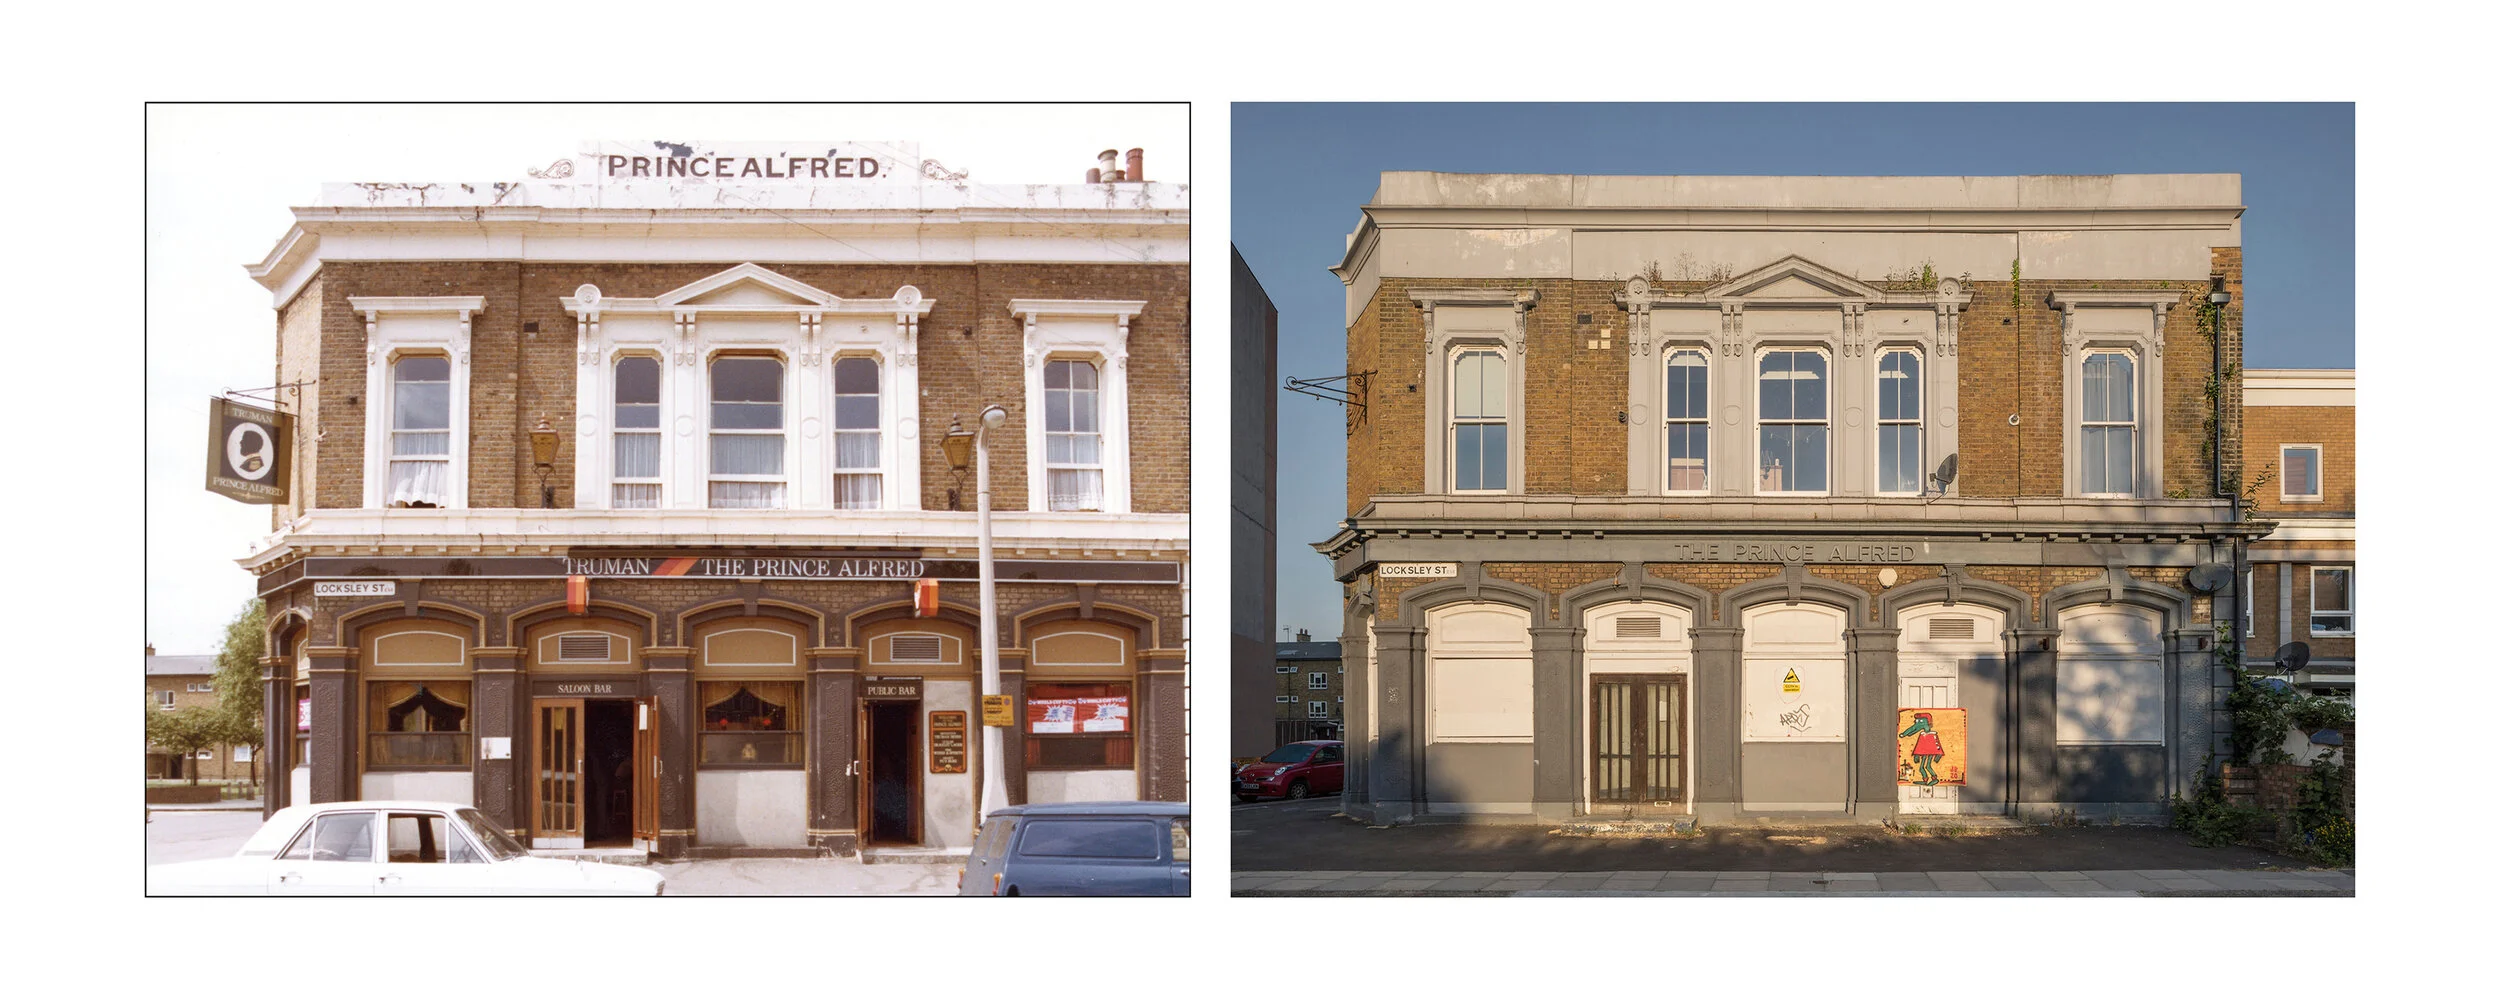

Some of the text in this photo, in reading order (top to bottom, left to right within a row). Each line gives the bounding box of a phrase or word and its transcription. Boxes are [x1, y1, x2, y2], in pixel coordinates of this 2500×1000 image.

[608, 155, 887, 179] PRINCE ALFRED.
[233, 408, 273, 424] TRUMAN
[213, 477, 284, 497] PRINCE ALFRED
[1674, 543, 1916, 562] THE PRINCE ALFRED
[563, 557, 650, 575] TRUMAN
[701, 558, 925, 578] THE PRINCE ALFRED
[1381, 566, 1432, 575] LOCKSLEY
[1434, 566, 1447, 575] ST
[315, 583, 369, 593] LOCKSLEY
[372, 584, 384, 593] ST
[558, 684, 612, 694] SALOON BAR
[867, 686, 917, 696] PUBLIC BAR
